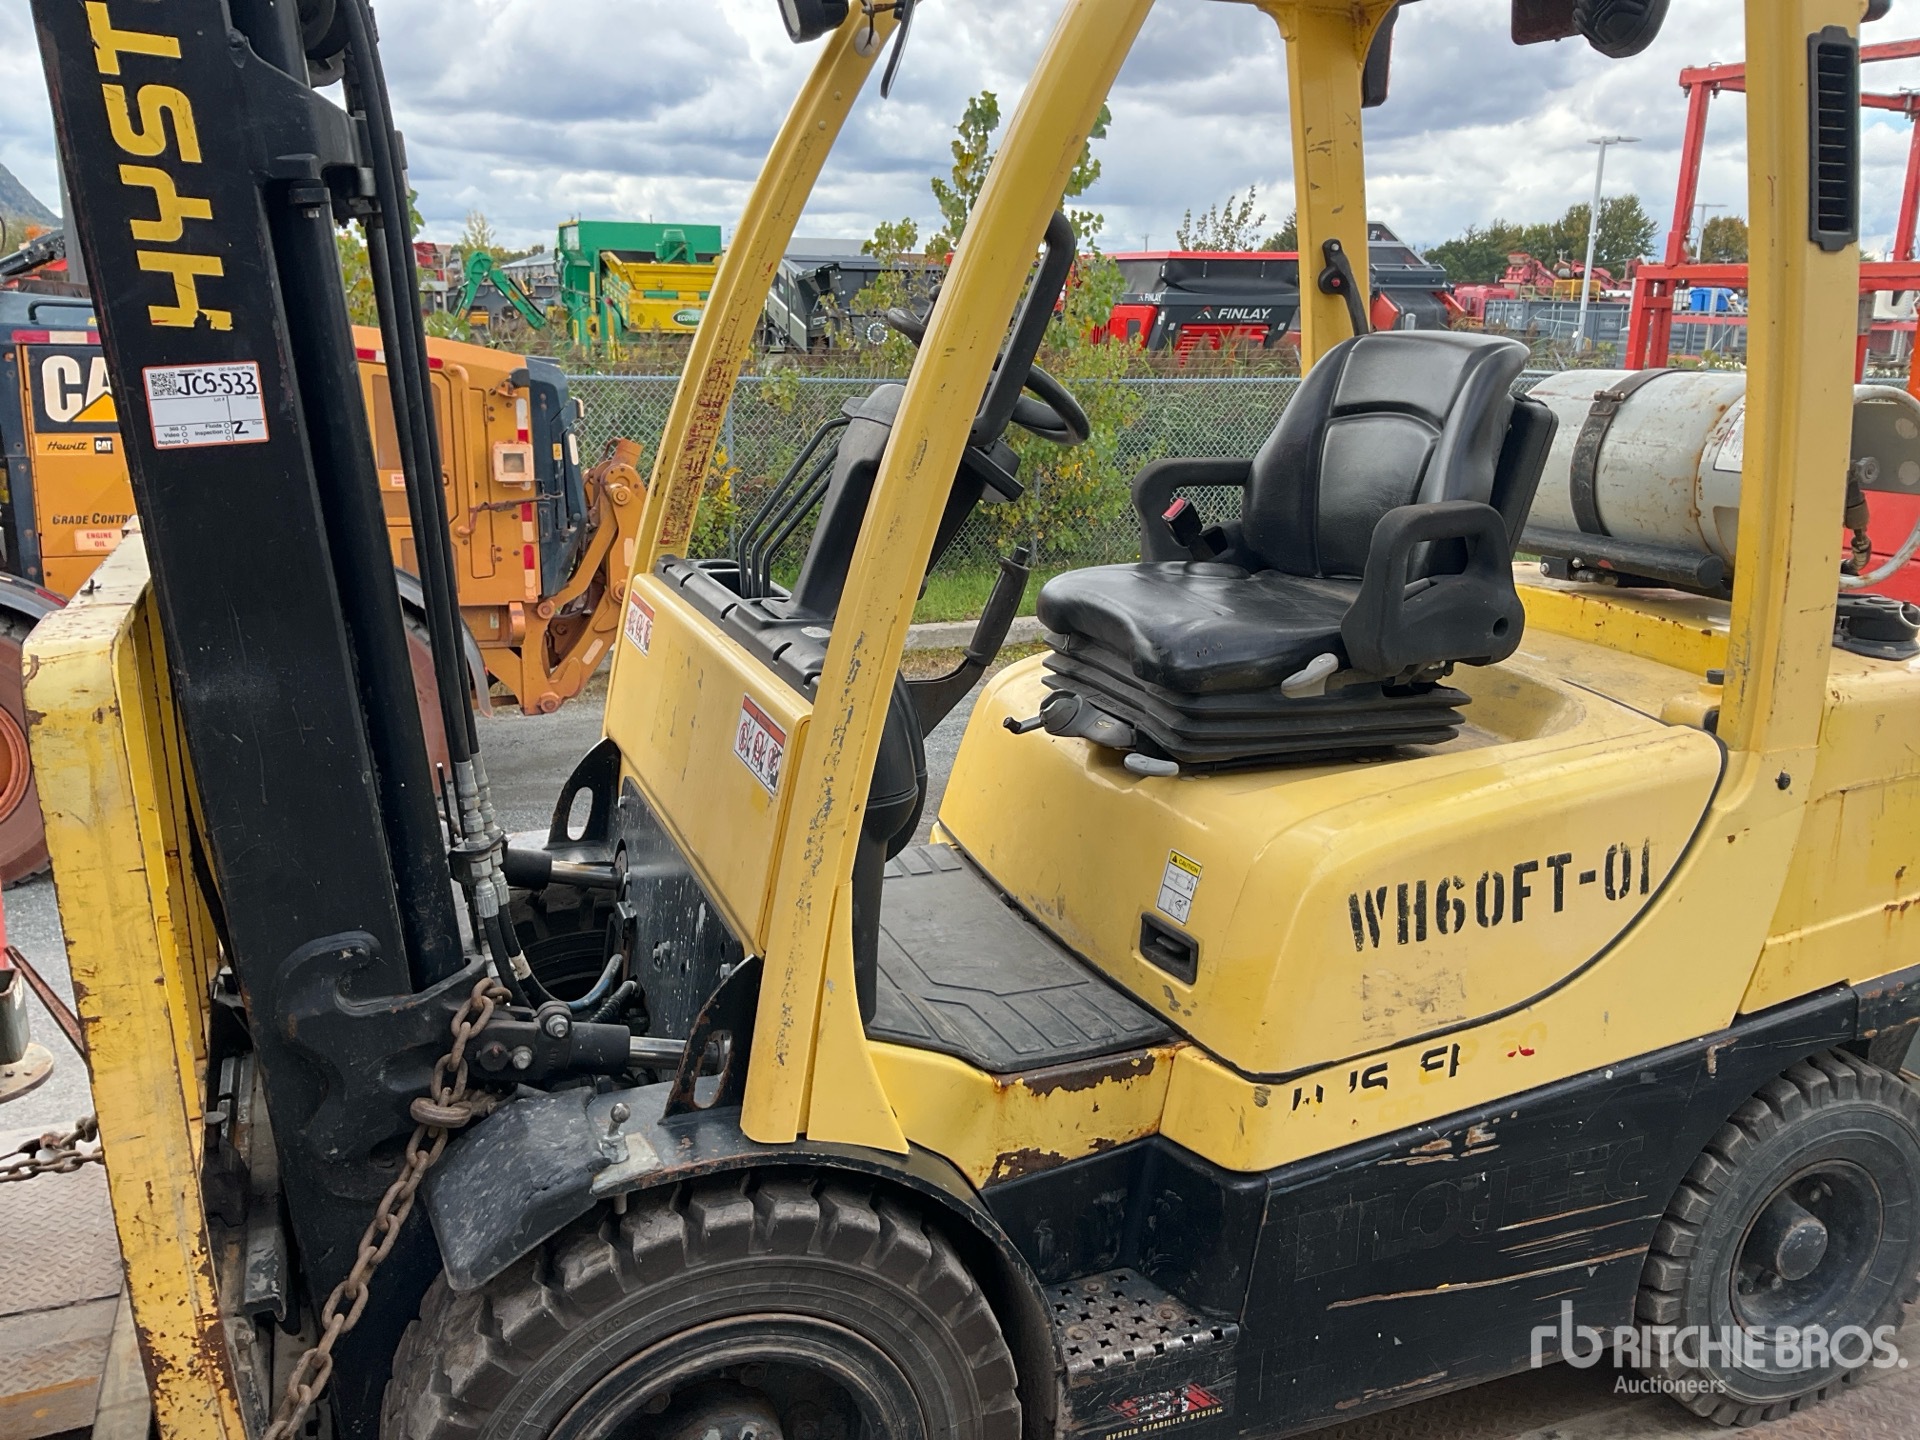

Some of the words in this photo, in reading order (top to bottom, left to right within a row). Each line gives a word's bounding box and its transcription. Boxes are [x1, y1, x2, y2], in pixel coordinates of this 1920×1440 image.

[85, 1, 234, 331] HYST
[1144, 293, 1162, 302] FINLAY
[1218, 308, 1271, 319] FINLAY
[42, 355, 112, 422] CA
[47, 441, 88, 451] Hewitt
[95, 440, 112, 451] CAT
[52, 513, 88, 525] GRADE
[92, 512, 134, 525] CONTR
[1178, 858, 1199, 873] CAUTION
[1142, 1416, 1187, 1432] STABILITY
[1190, 1407, 1223, 1420] SYSTEM
